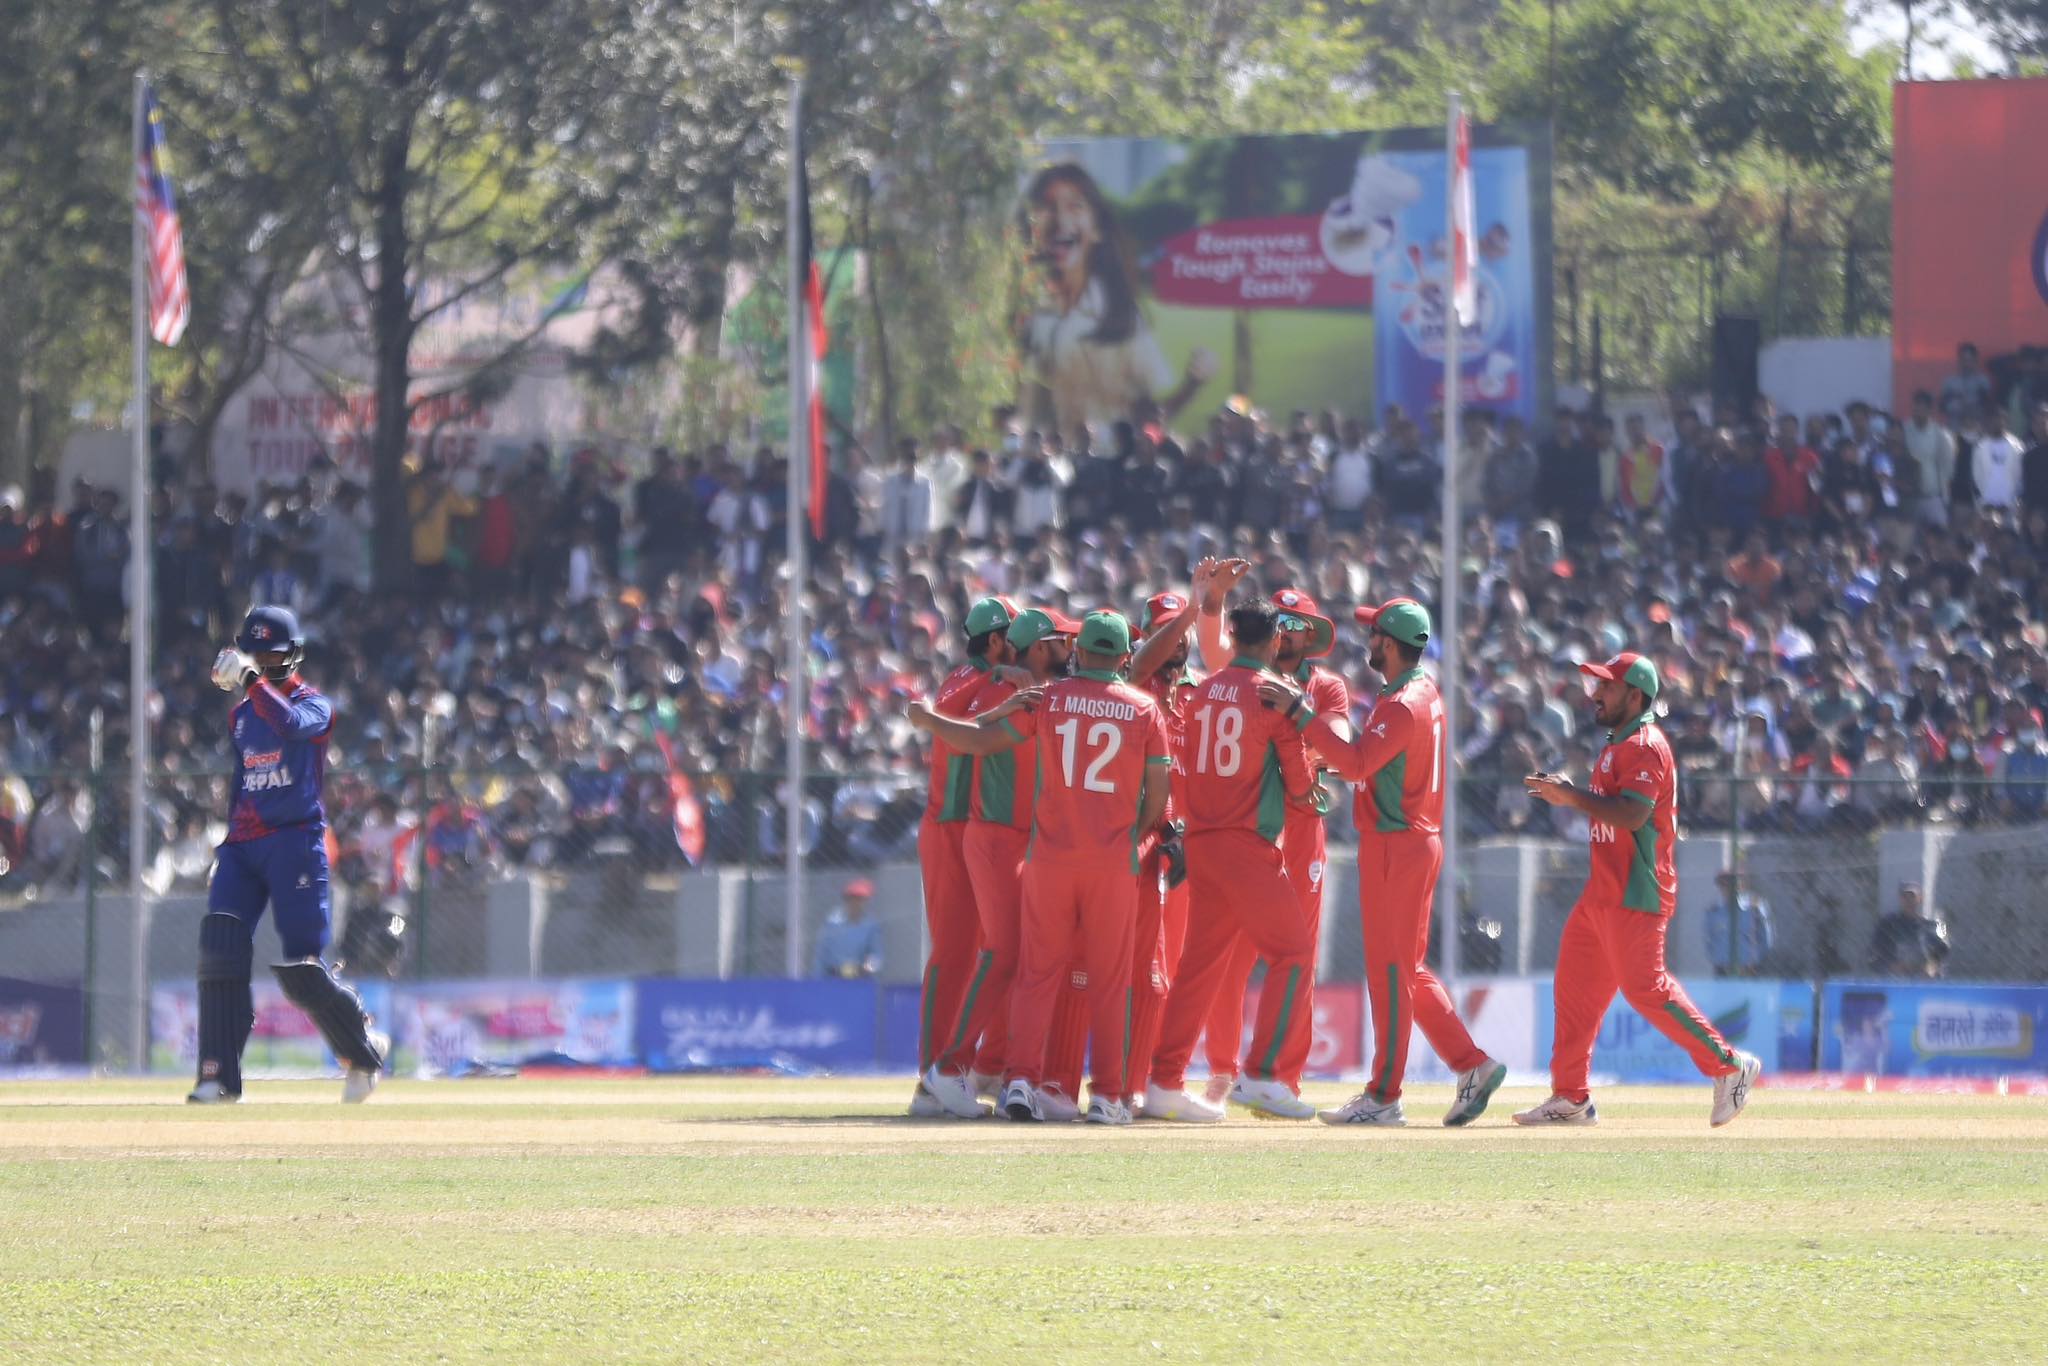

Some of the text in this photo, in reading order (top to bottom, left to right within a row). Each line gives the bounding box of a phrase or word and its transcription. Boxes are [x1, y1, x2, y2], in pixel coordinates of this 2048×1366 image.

[1197, 231, 1309, 254] Removes
[1172, 254, 1328, 283] Tough Stains
[1241, 276, 1314, 303] Easily
[1207, 683, 1239, 703] BILAL
[1049, 696, 1135, 721] Z. MAQSOOD
[1194, 704, 1244, 777] 18
[1055, 719, 1121, 793] 12
